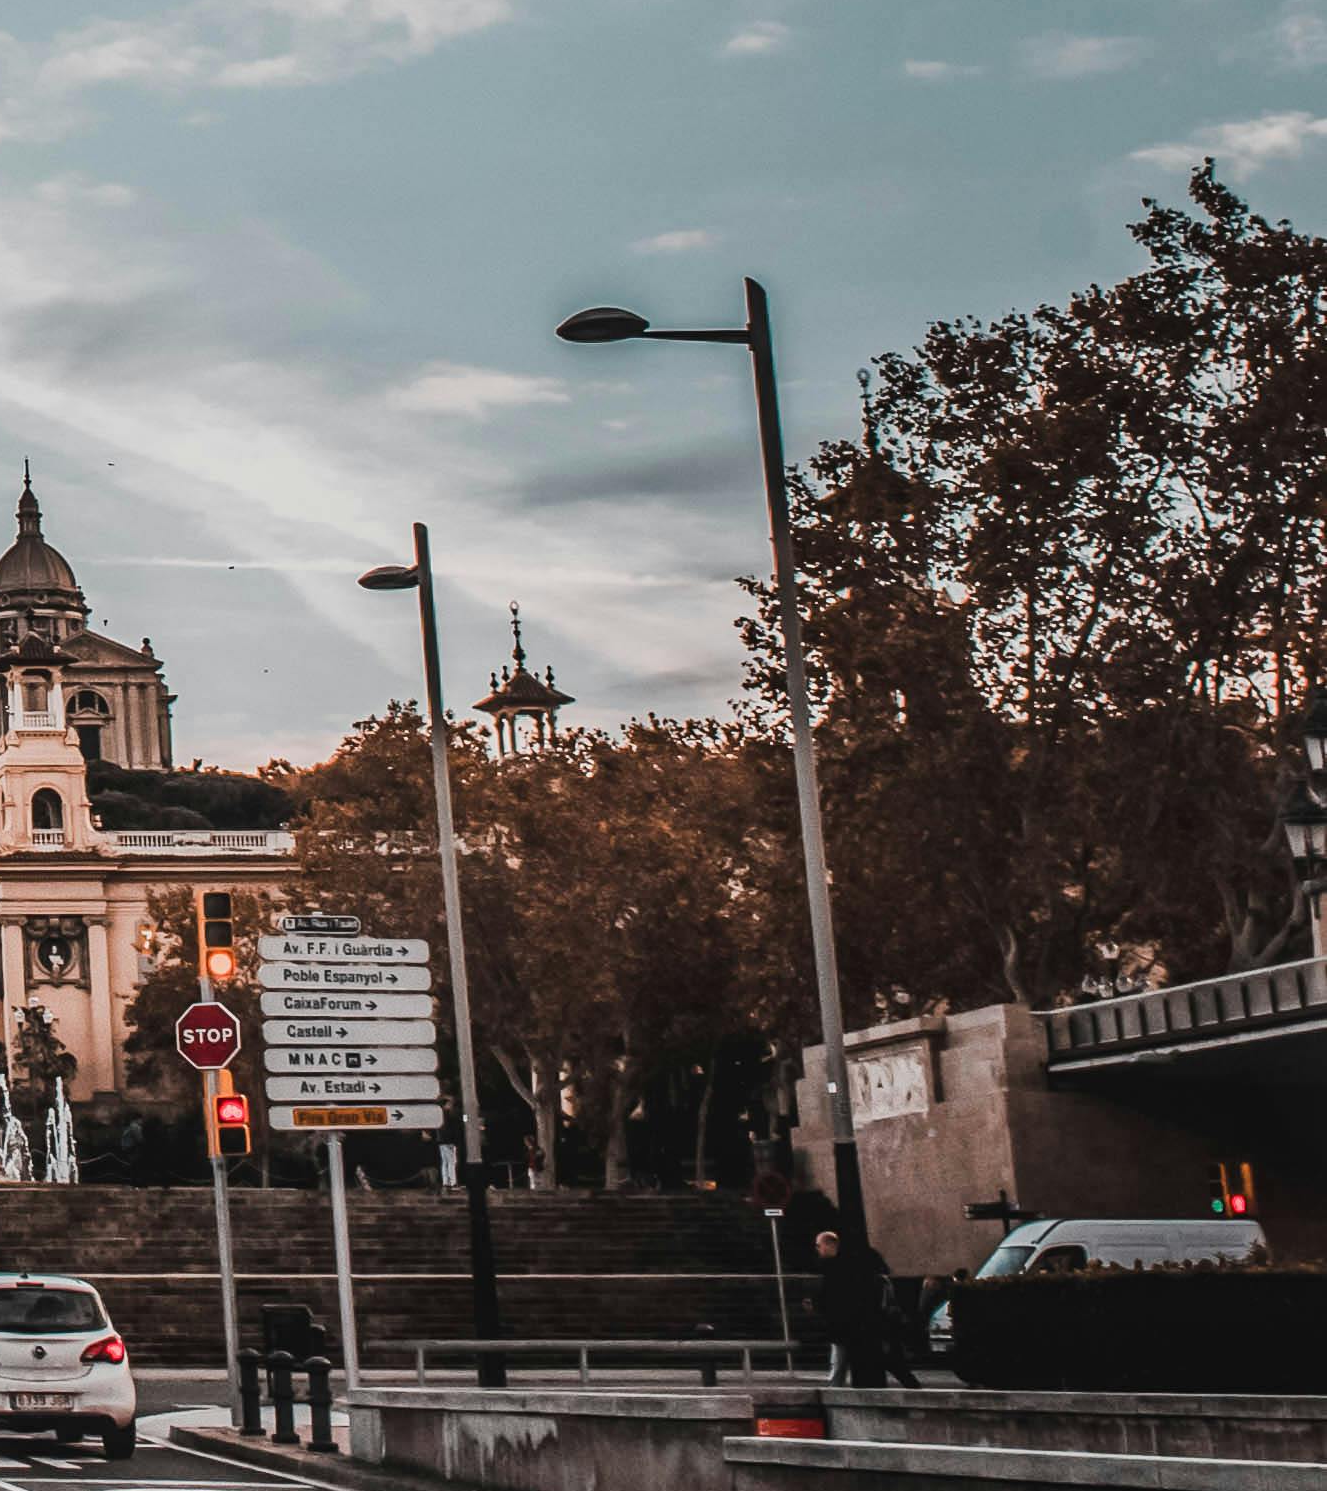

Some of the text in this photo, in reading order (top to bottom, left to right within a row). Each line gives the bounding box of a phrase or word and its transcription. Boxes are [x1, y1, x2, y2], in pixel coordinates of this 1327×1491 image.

[283, 941, 303, 955] Av.
[307, 942, 331, 955] F.F.
[342, 942, 394, 956] Guàrdia
[283, 968, 382, 986] Poble Espanyol
[284, 996, 362, 1010] CaixaForum
[183, 1028, 233, 1044] STOP
[287, 1024, 332, 1038] Castell
[300, 1080, 366, 1094] Av. Estadi
